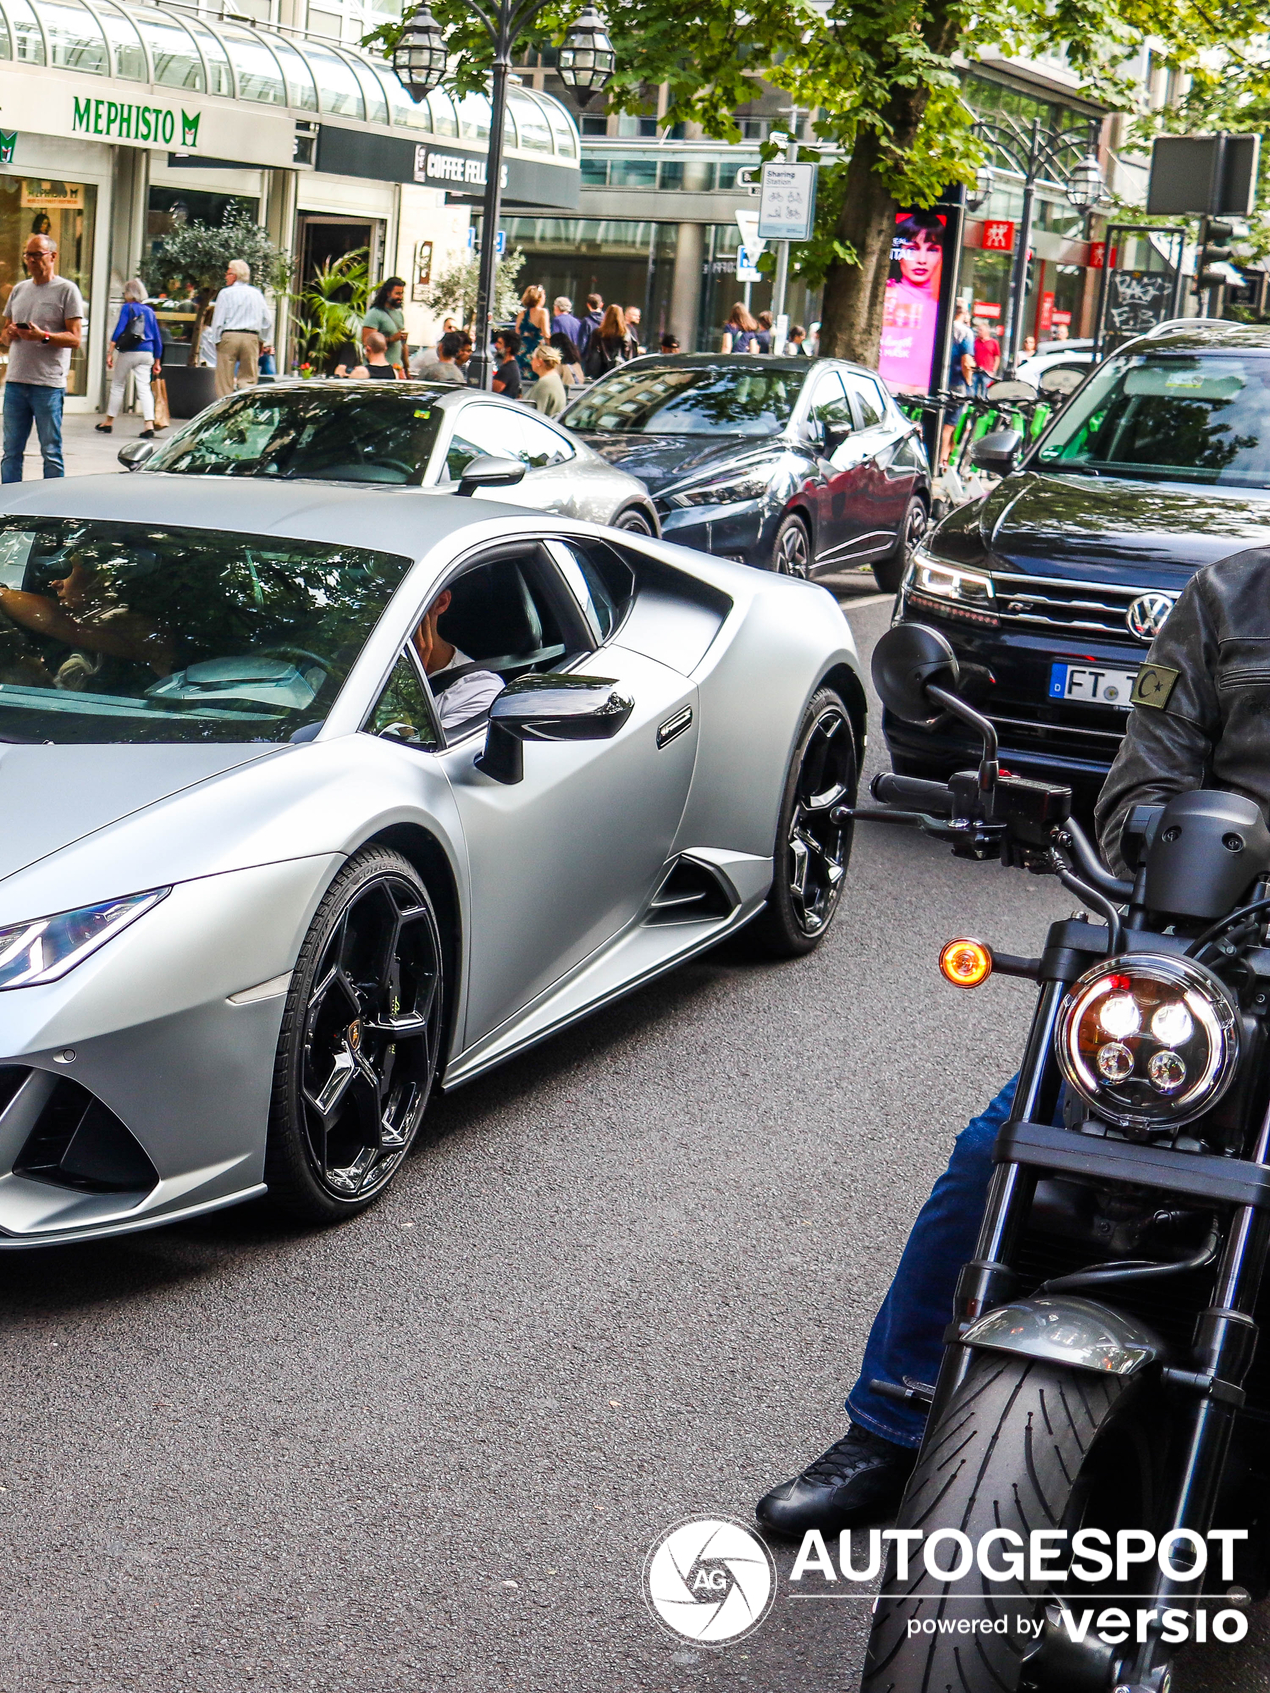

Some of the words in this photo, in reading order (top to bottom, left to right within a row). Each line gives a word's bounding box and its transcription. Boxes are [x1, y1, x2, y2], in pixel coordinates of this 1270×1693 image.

[72, 96, 175, 145] MEPHISTO
[427, 153, 464, 182] COFFEE
[465, 159, 509, 189] FELLS
[766, 170, 796, 179] Sharing
[766, 178, 792, 186] Station
[1054, 683, 1061, 692] D
[1068, 670, 1106, 697] FT
